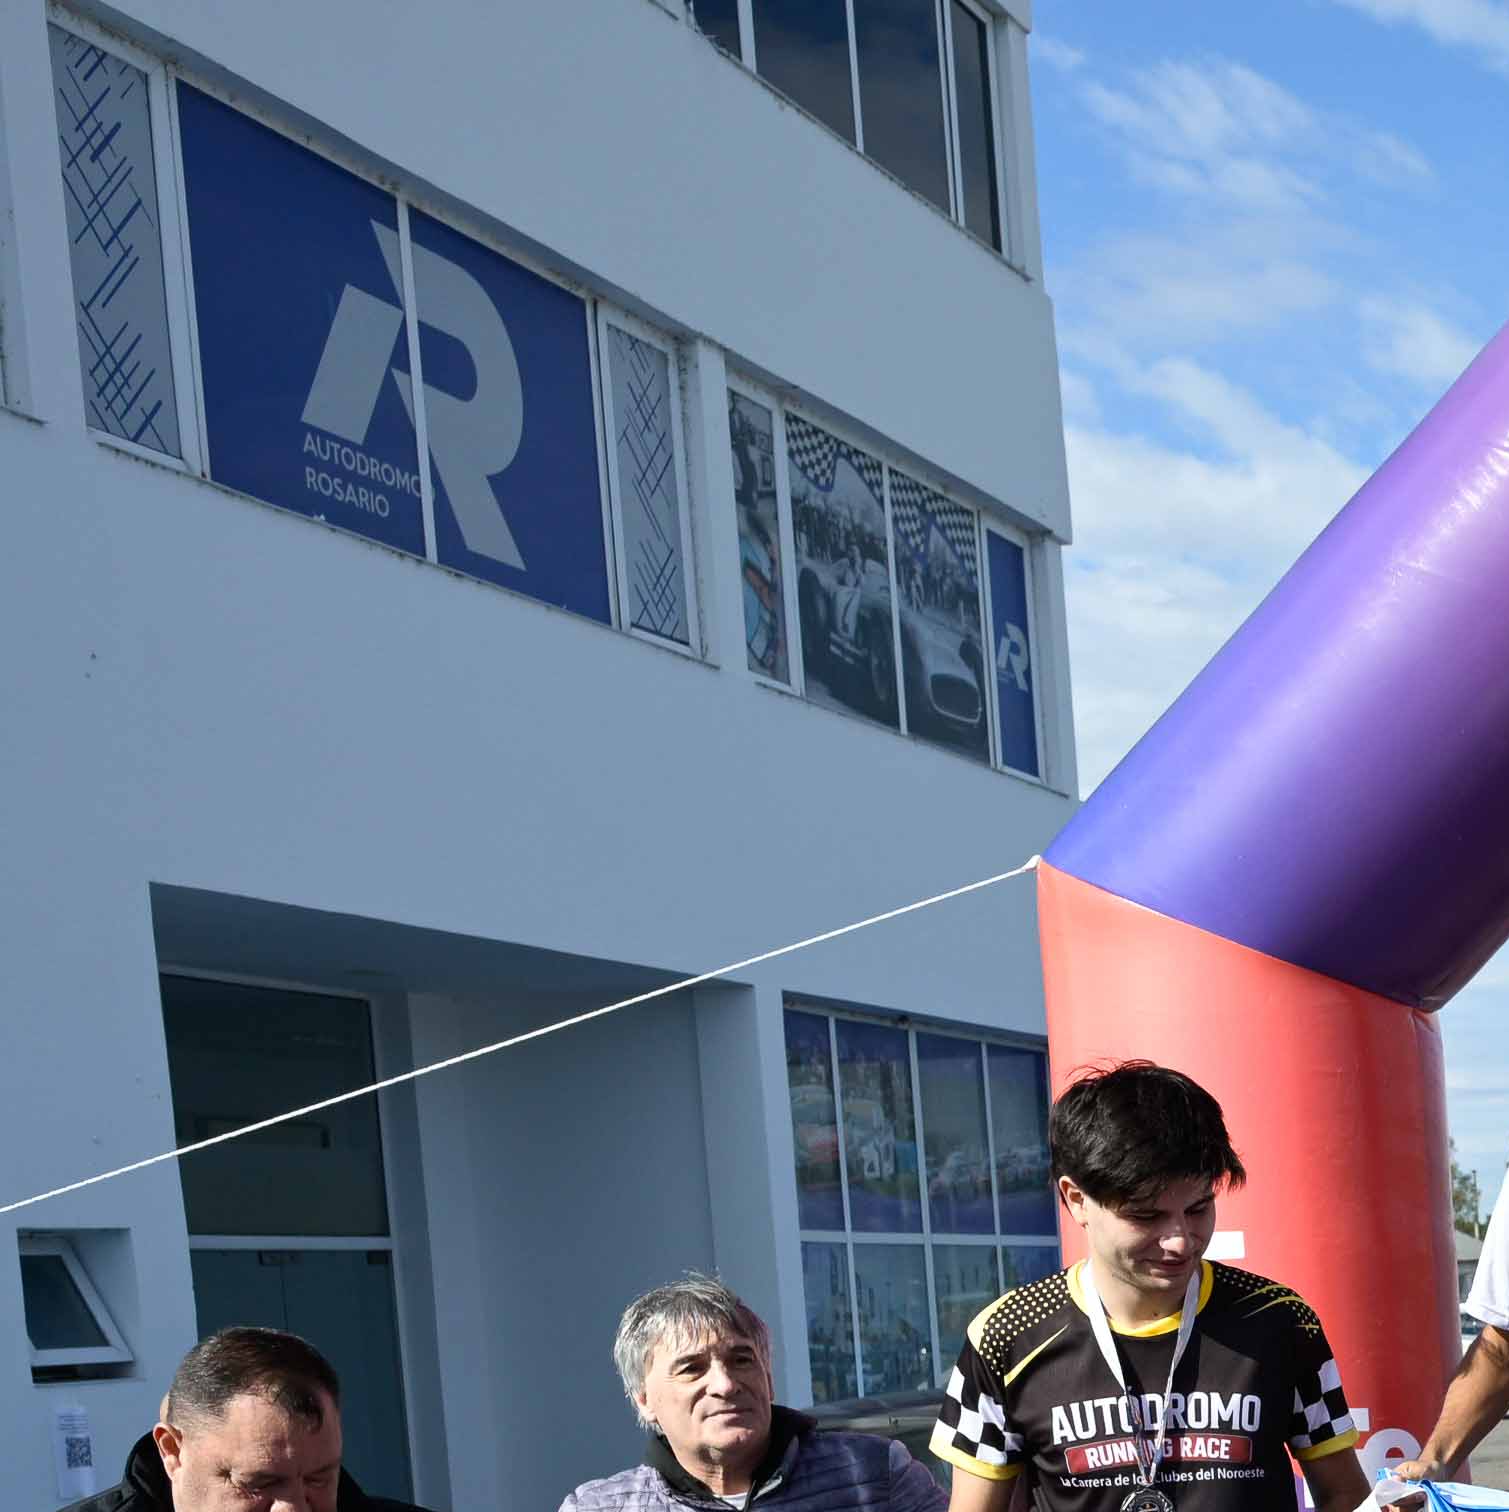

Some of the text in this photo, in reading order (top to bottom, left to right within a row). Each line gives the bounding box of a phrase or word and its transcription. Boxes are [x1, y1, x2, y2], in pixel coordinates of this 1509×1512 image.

[303, 431, 435, 500] AUTODROMO
[305, 466, 390, 518] ROSARIO
[1051, 1391, 1262, 1446] AUTODROMO
[1072, 1476, 1111, 1488] Carrera
[1114, 1475, 1130, 1486] de
[1133, 1474, 1151, 1486] lo
[1198, 1468, 1215, 1480] del
[1217, 1467, 1265, 1480] Noroeste
[1085, 1437, 1232, 1469] RUNNNG RACE
